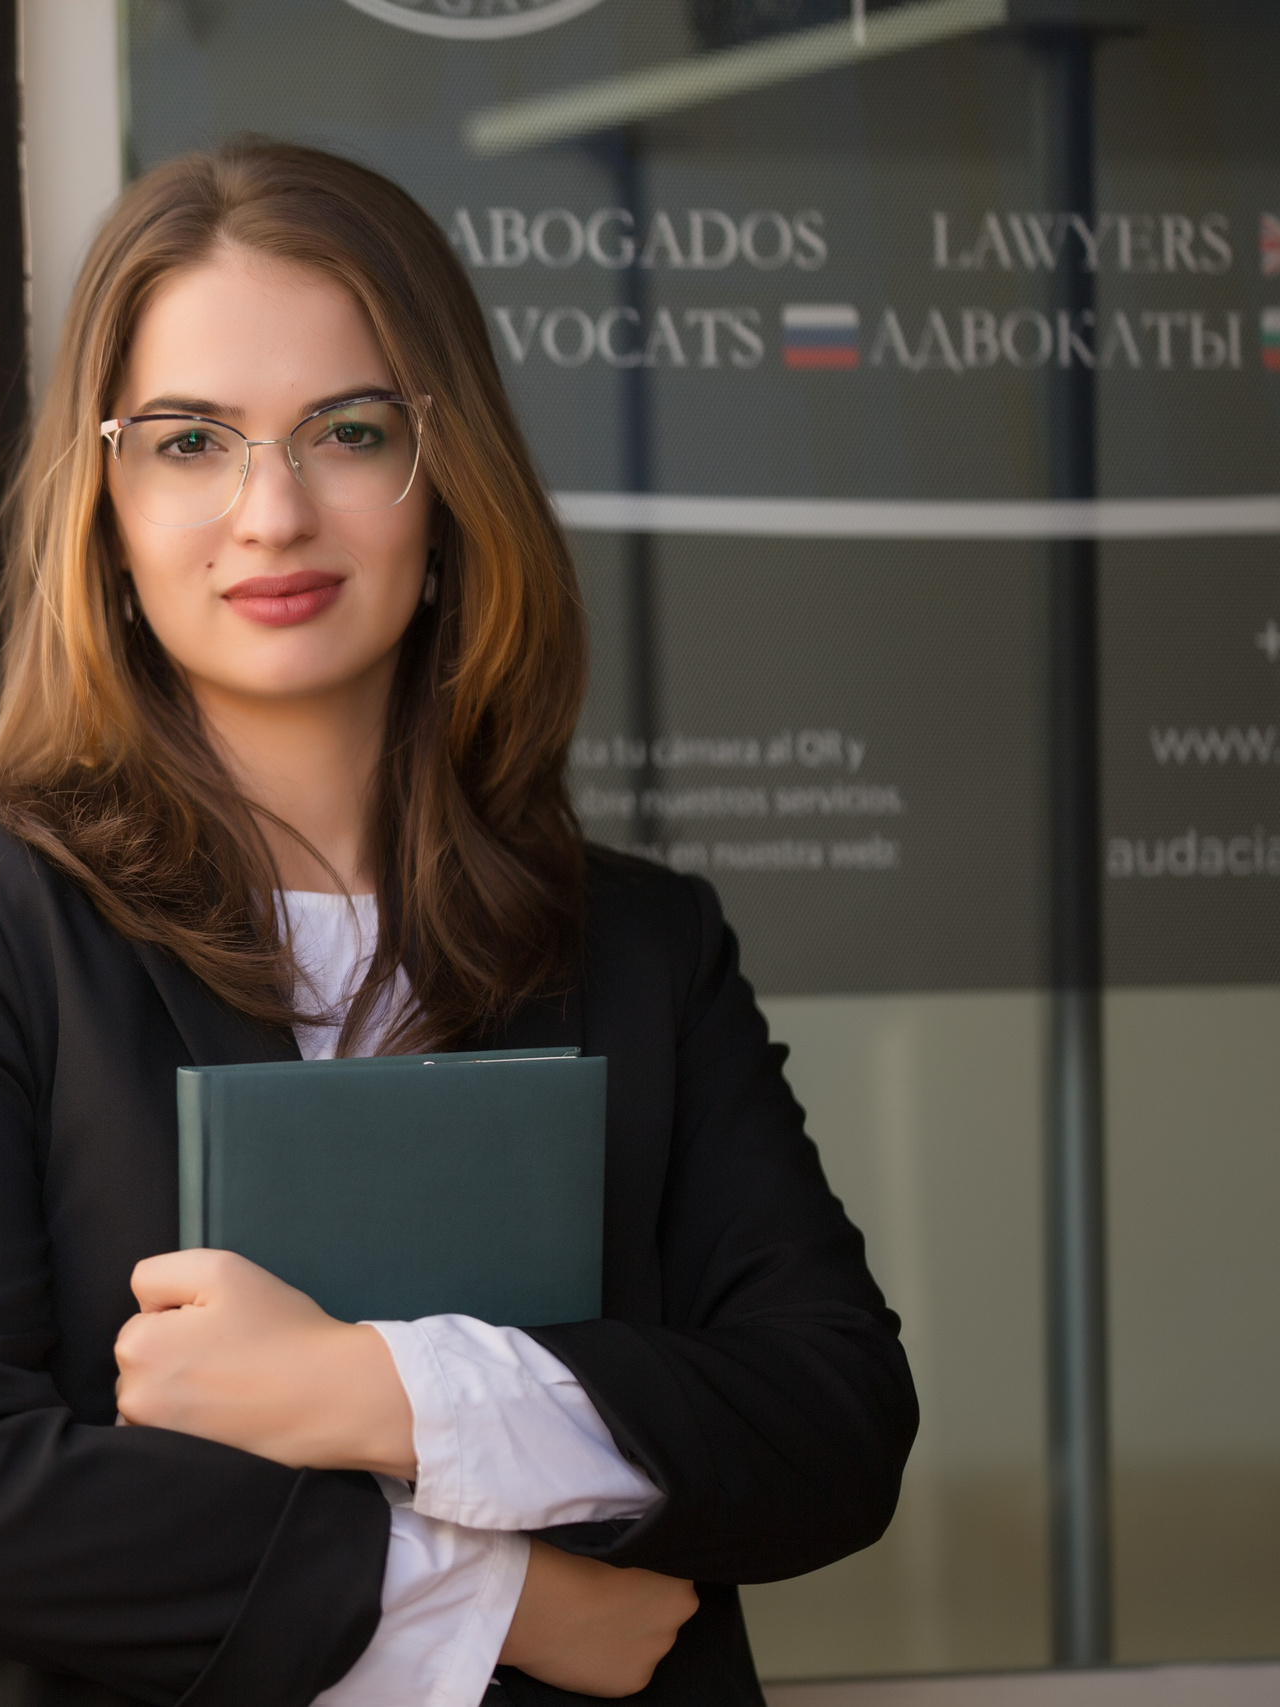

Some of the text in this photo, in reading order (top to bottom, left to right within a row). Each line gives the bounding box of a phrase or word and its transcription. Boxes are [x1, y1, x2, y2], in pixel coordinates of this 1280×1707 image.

[449, 208, 1233, 273] ABOGADOS LAWYERS
[494, 307, 764, 369] VOCATS
[870, 308, 1242, 373] АДВОКАТЫ
[846, 738, 866, 773] y
